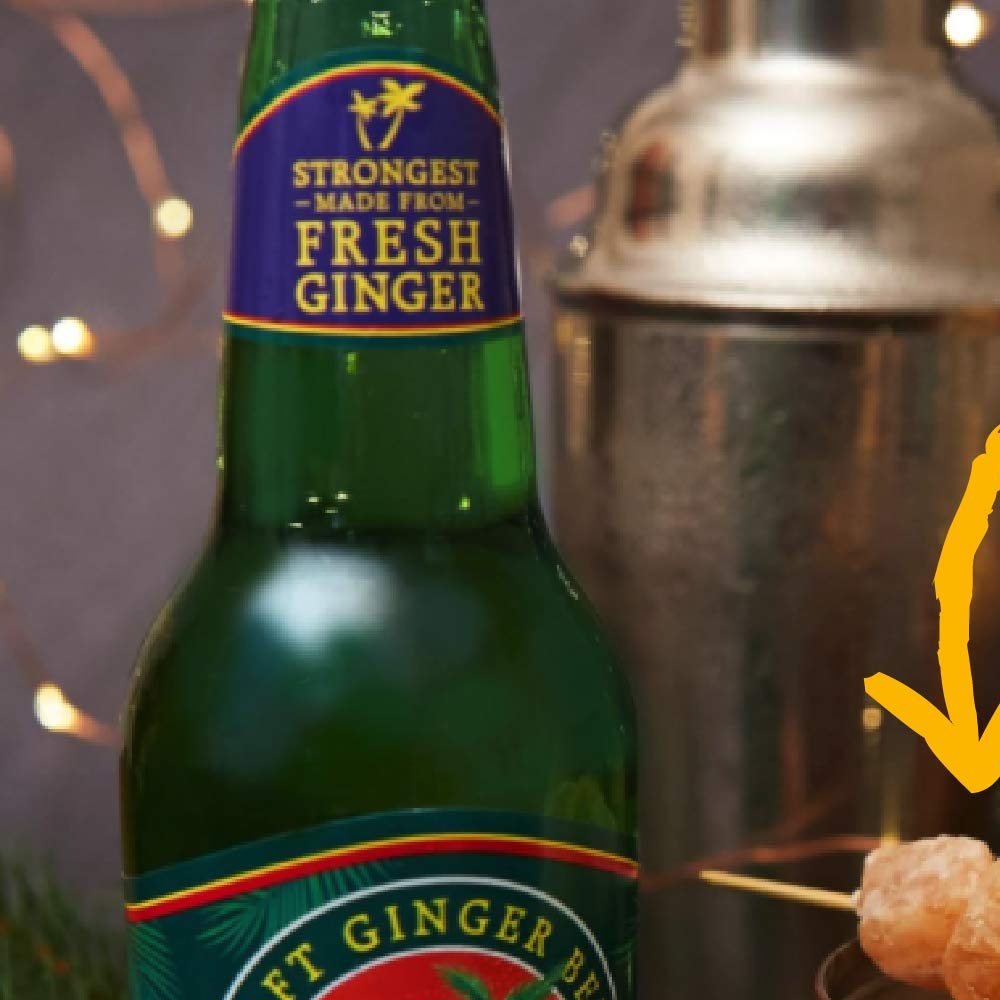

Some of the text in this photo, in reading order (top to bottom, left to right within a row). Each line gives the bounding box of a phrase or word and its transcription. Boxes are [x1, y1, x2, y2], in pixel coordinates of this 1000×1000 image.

[292, 159, 479, 187] STRONGEST
[315, 192, 465, 213] MADE FROM
[295, 219, 481, 266] FRESH
[295, 271, 485, 315] GINGER
[342, 897, 553, 957] GINGER
